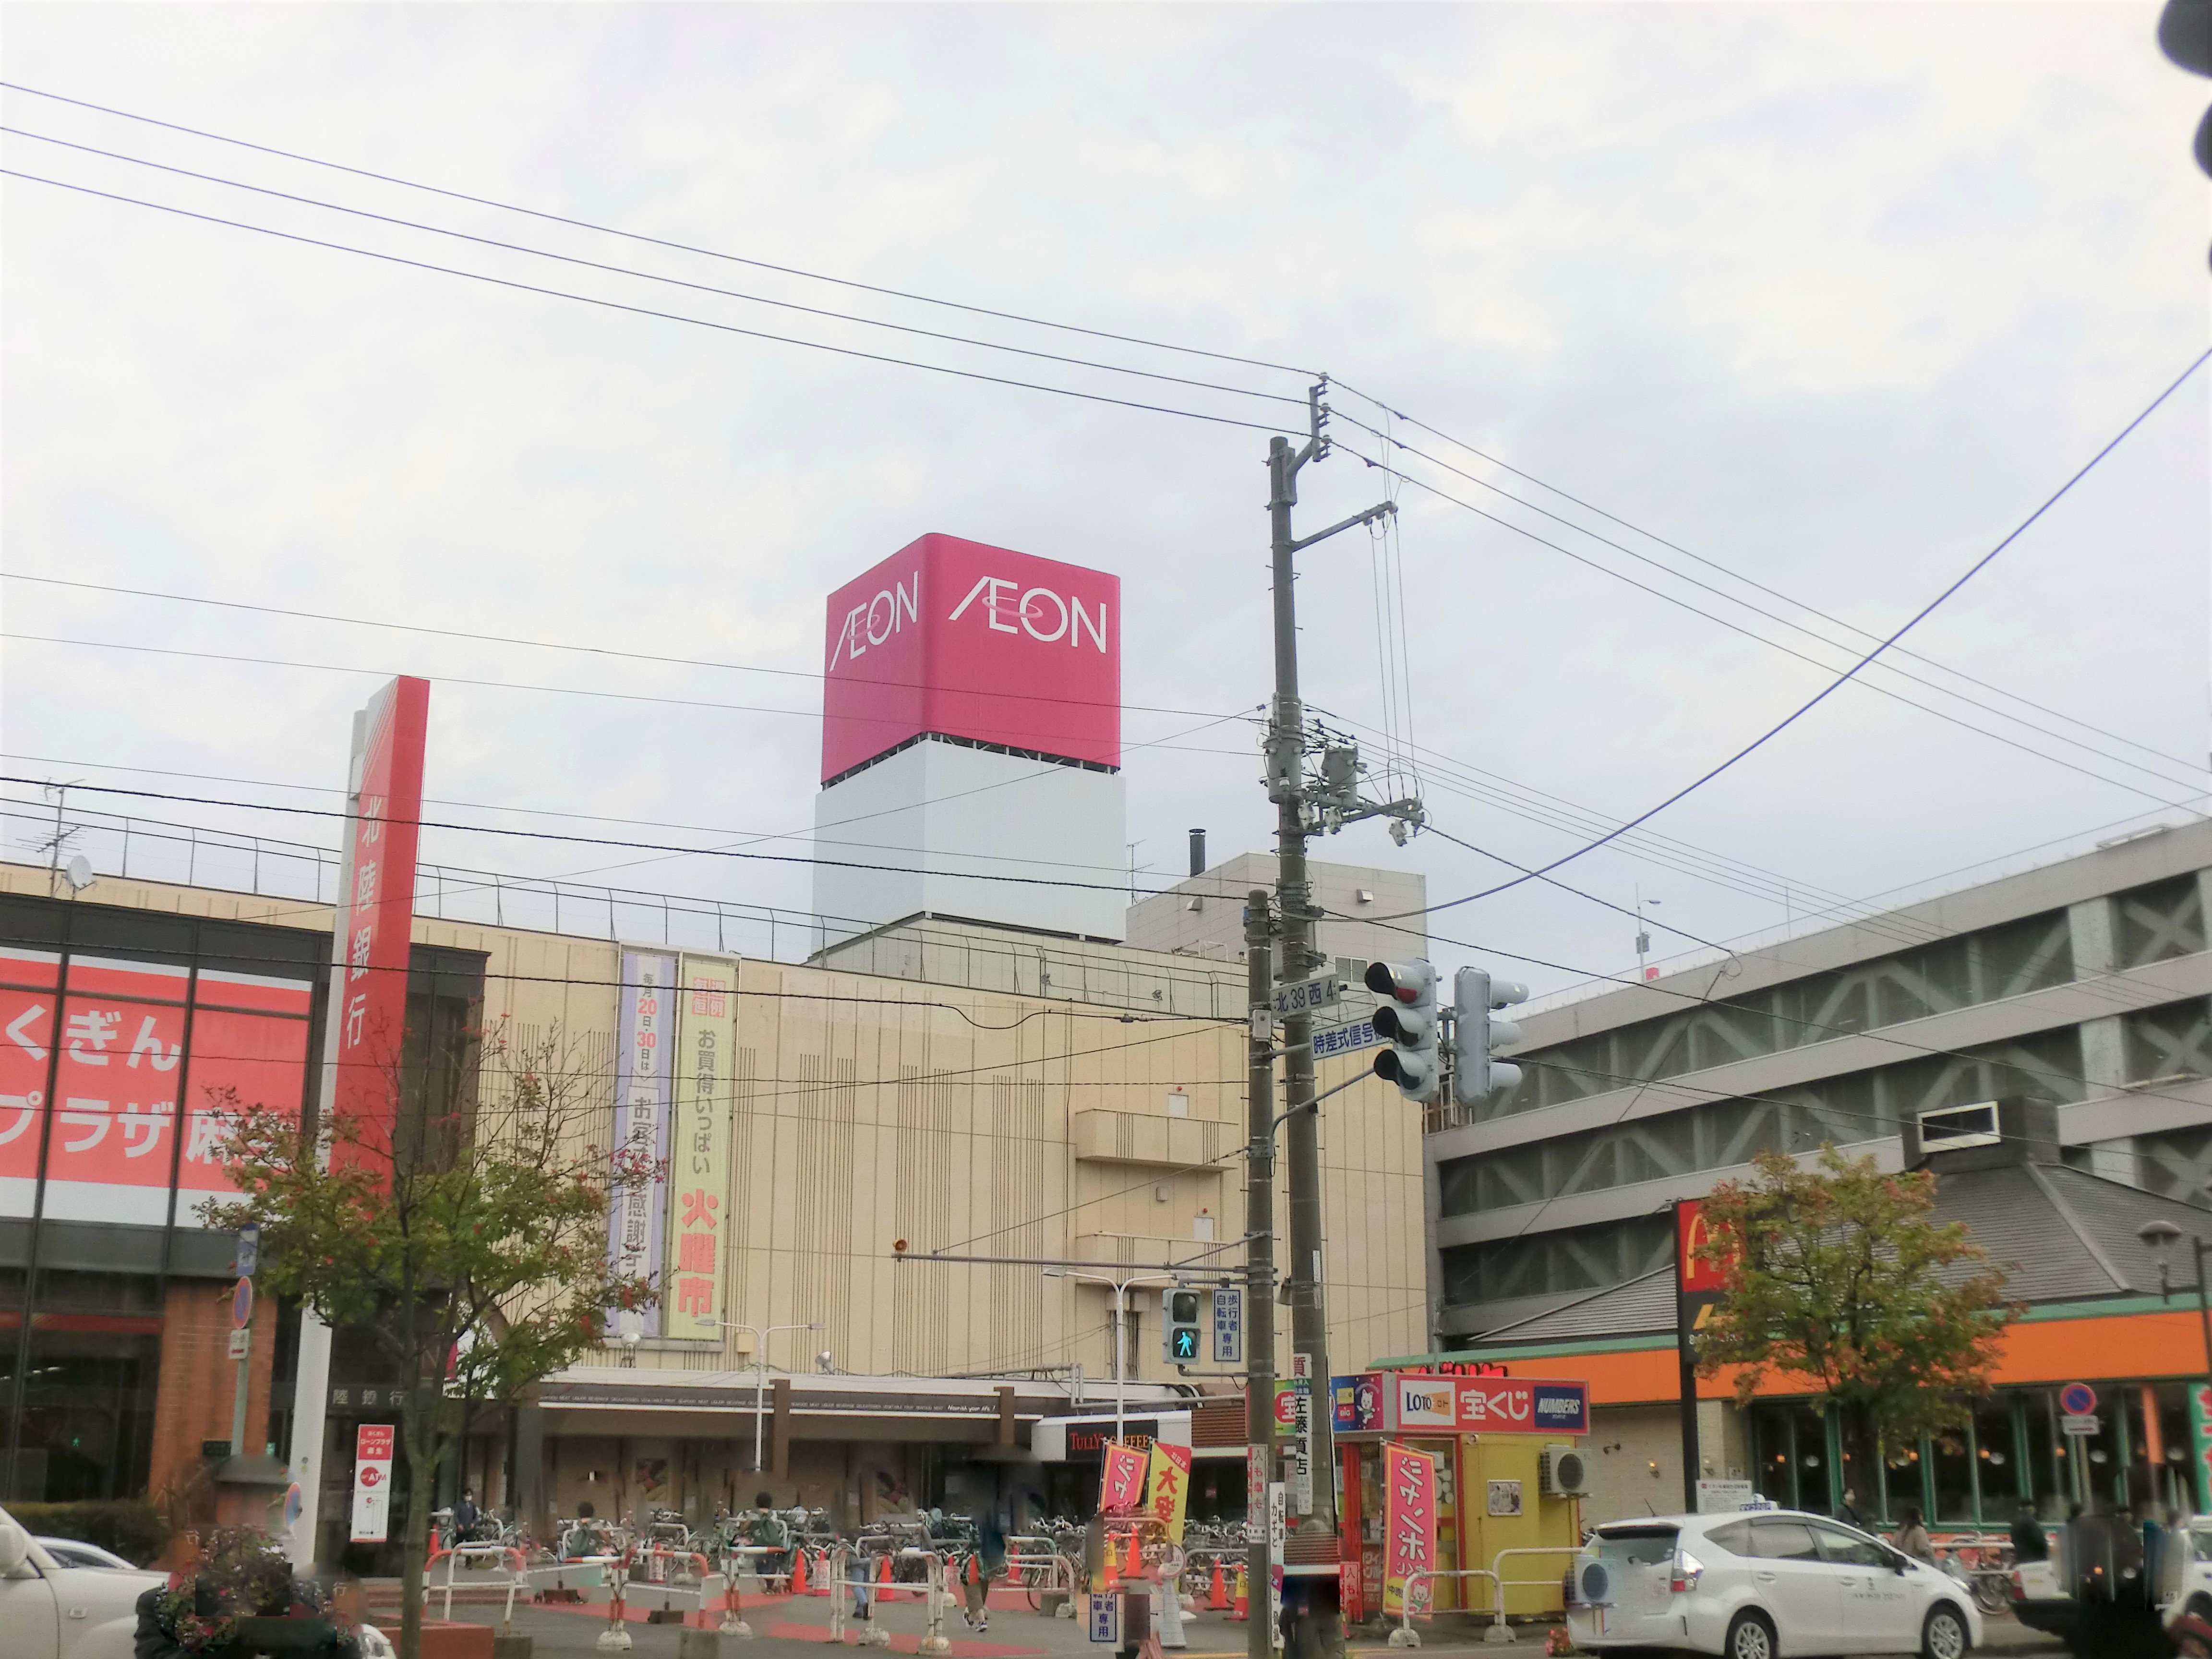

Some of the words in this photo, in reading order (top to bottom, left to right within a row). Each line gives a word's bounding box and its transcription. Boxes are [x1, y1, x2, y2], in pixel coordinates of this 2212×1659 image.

[347, 794, 382, 1049] 北陸銀行
[5, 1004, 181, 1071] くぎん
[1313, 1022, 1388, 1054] 時差式信号
[678, 1189, 719, 1317] 火曜市
[1406, 1391, 1431, 1412] LOTO
[1460, 1389, 1529, 1421] 宝くじ
[1537, 1397, 1581, 1415] NUMBERS
